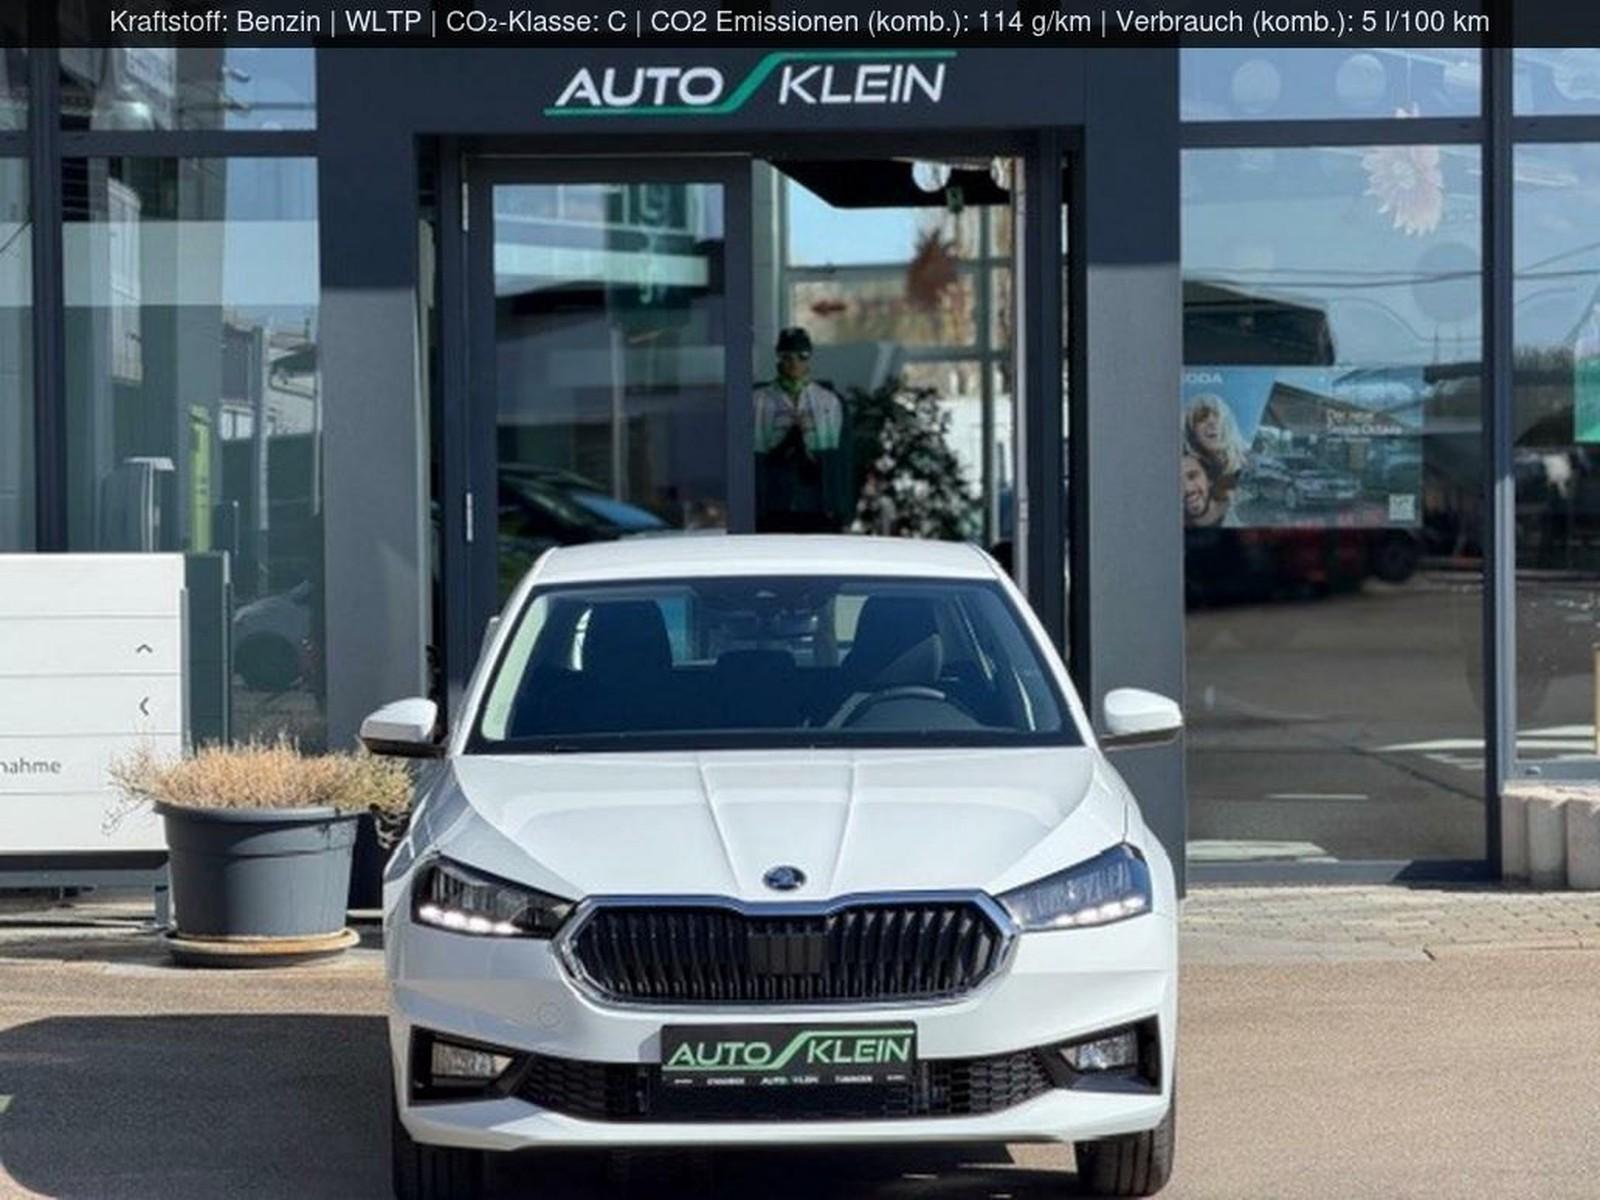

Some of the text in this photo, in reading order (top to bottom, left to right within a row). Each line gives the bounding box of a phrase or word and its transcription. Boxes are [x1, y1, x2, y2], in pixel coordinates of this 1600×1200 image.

[554, 63, 946, 107] AUTO KLEIN
[667, 1037, 912, 1067] AUTO KLEIN
